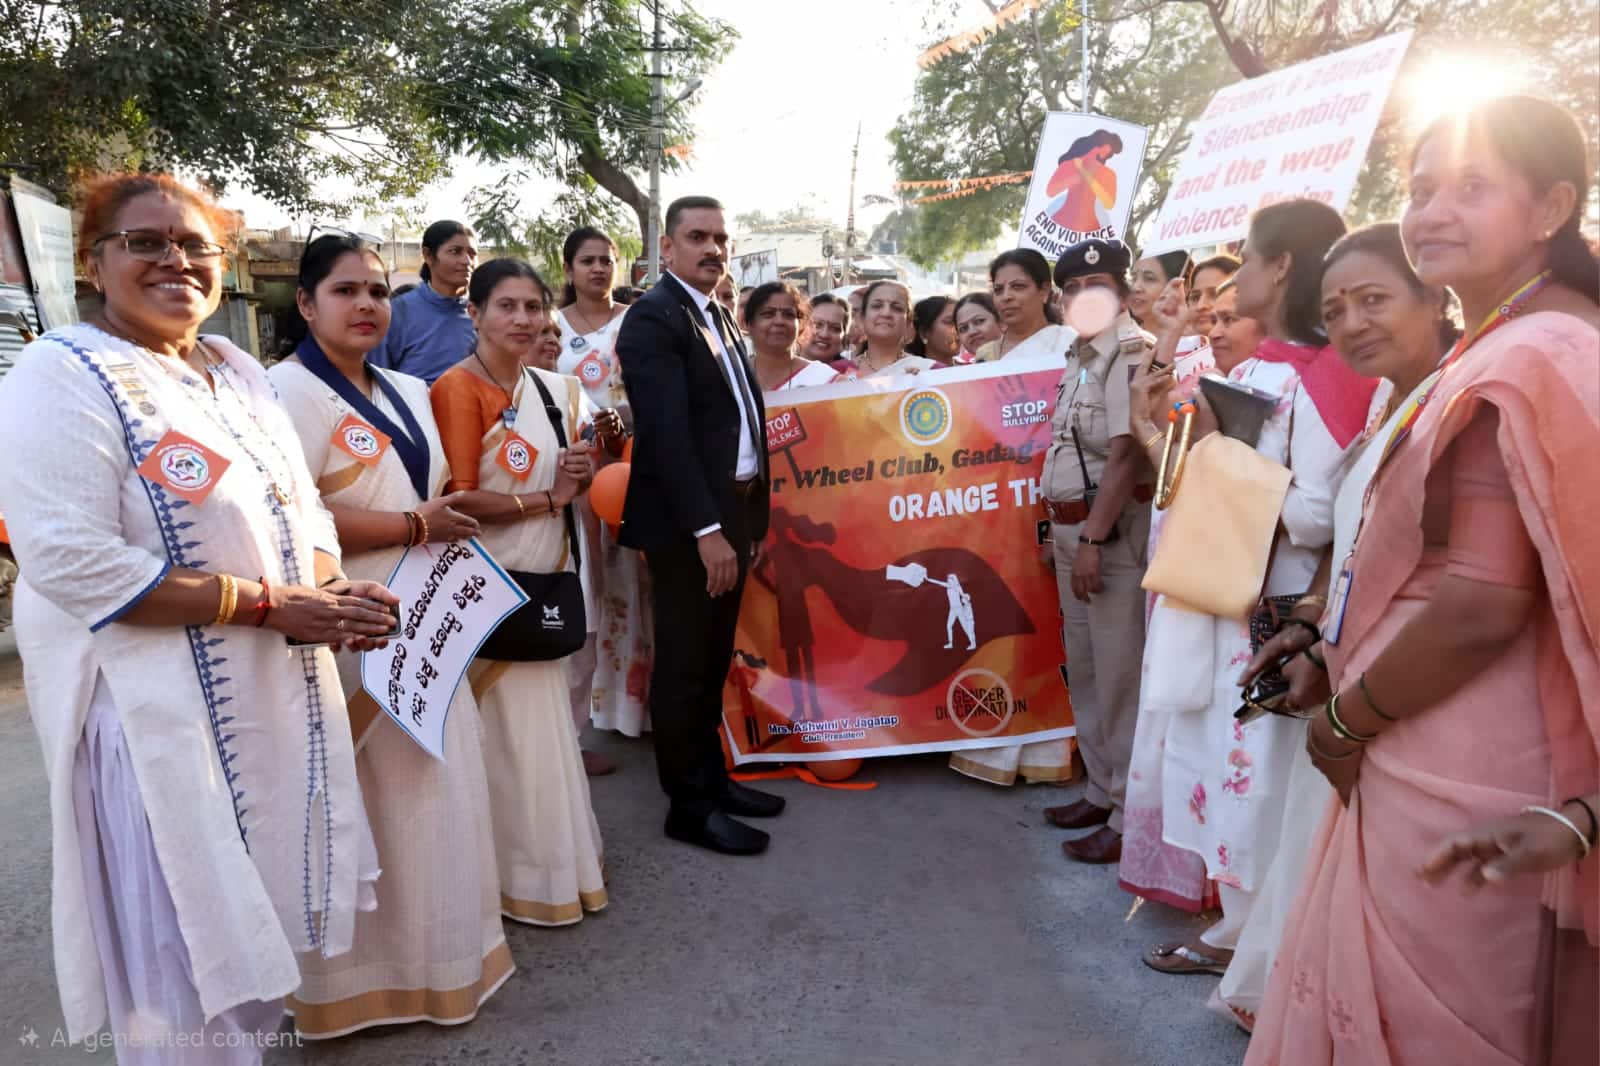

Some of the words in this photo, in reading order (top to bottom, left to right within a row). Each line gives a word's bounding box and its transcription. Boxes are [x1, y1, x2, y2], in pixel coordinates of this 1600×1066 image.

[1174, 164, 1221, 200] and
[1224, 155, 1267, 188] the
[1035, 210, 1057, 235] END
[1159, 203, 1249, 240] violence
[1025, 224, 1067, 257] AGAINS
[1002, 400, 1047, 418] STOP
[1003, 414, 1049, 427] BULLYING!
[766, 412, 791, 435] TOP
[767, 426, 801, 447] IOLENCE
[797, 460, 875, 489] Wheel
[881, 452, 945, 479] Club,
[889, 483, 999, 522] ORANGE
[953, 686, 1005, 704] GENDER
[768, 723, 791, 735] Mrs.
[793, 720, 838, 734] Ashwini
[841, 719, 852, 730] V.
[855, 715, 899, 728] Jagatap
[802, 733, 823, 743] Club
[824, 730, 865, 741] President
